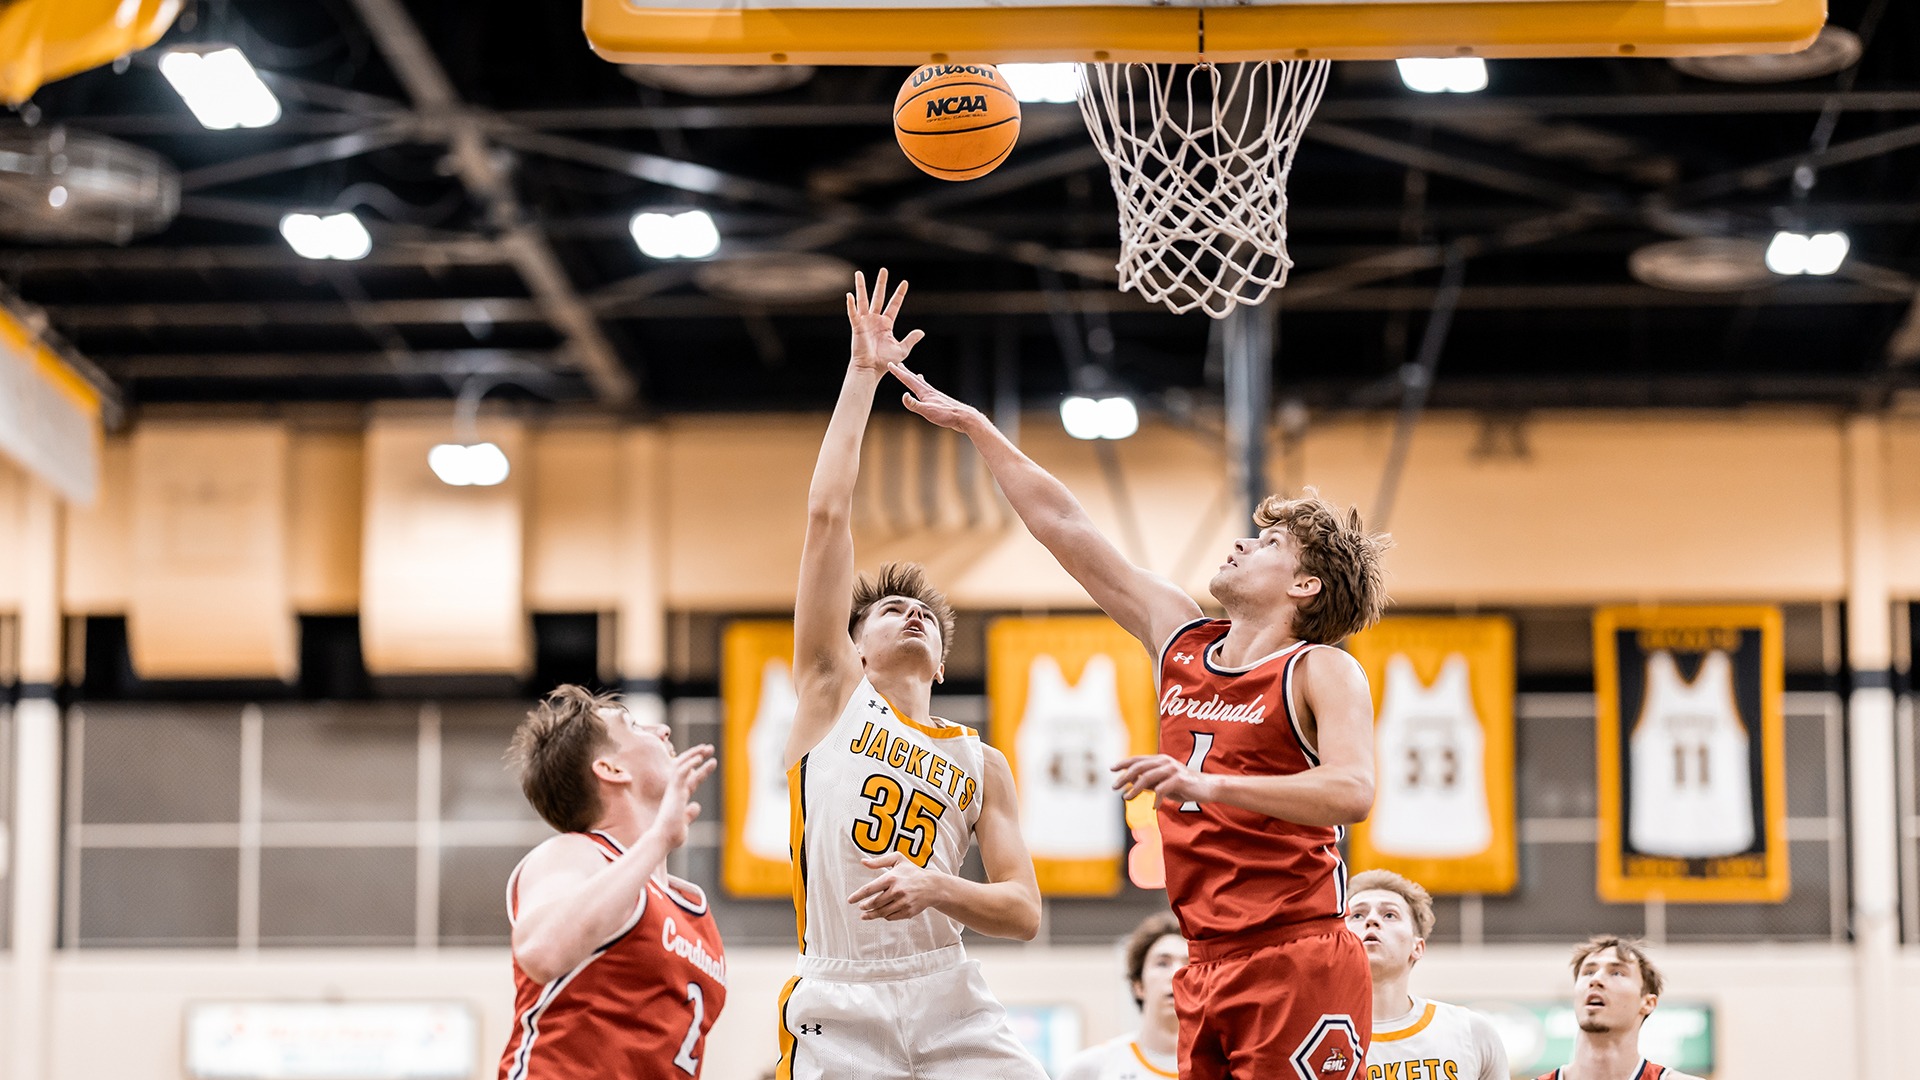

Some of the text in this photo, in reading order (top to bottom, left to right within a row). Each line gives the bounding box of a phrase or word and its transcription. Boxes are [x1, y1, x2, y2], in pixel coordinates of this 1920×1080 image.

[912, 64, 995, 87] Wilson
[927, 96, 987, 118] NCAA
[1160, 684, 1267, 724] Cardinals
[850, 721, 976, 812] JACKETS
[1179, 730, 1214, 813] 1
[851, 773, 946, 869] 35
[672, 981, 704, 1077] 2
[1366, 1058, 1459, 1080] CKETS
